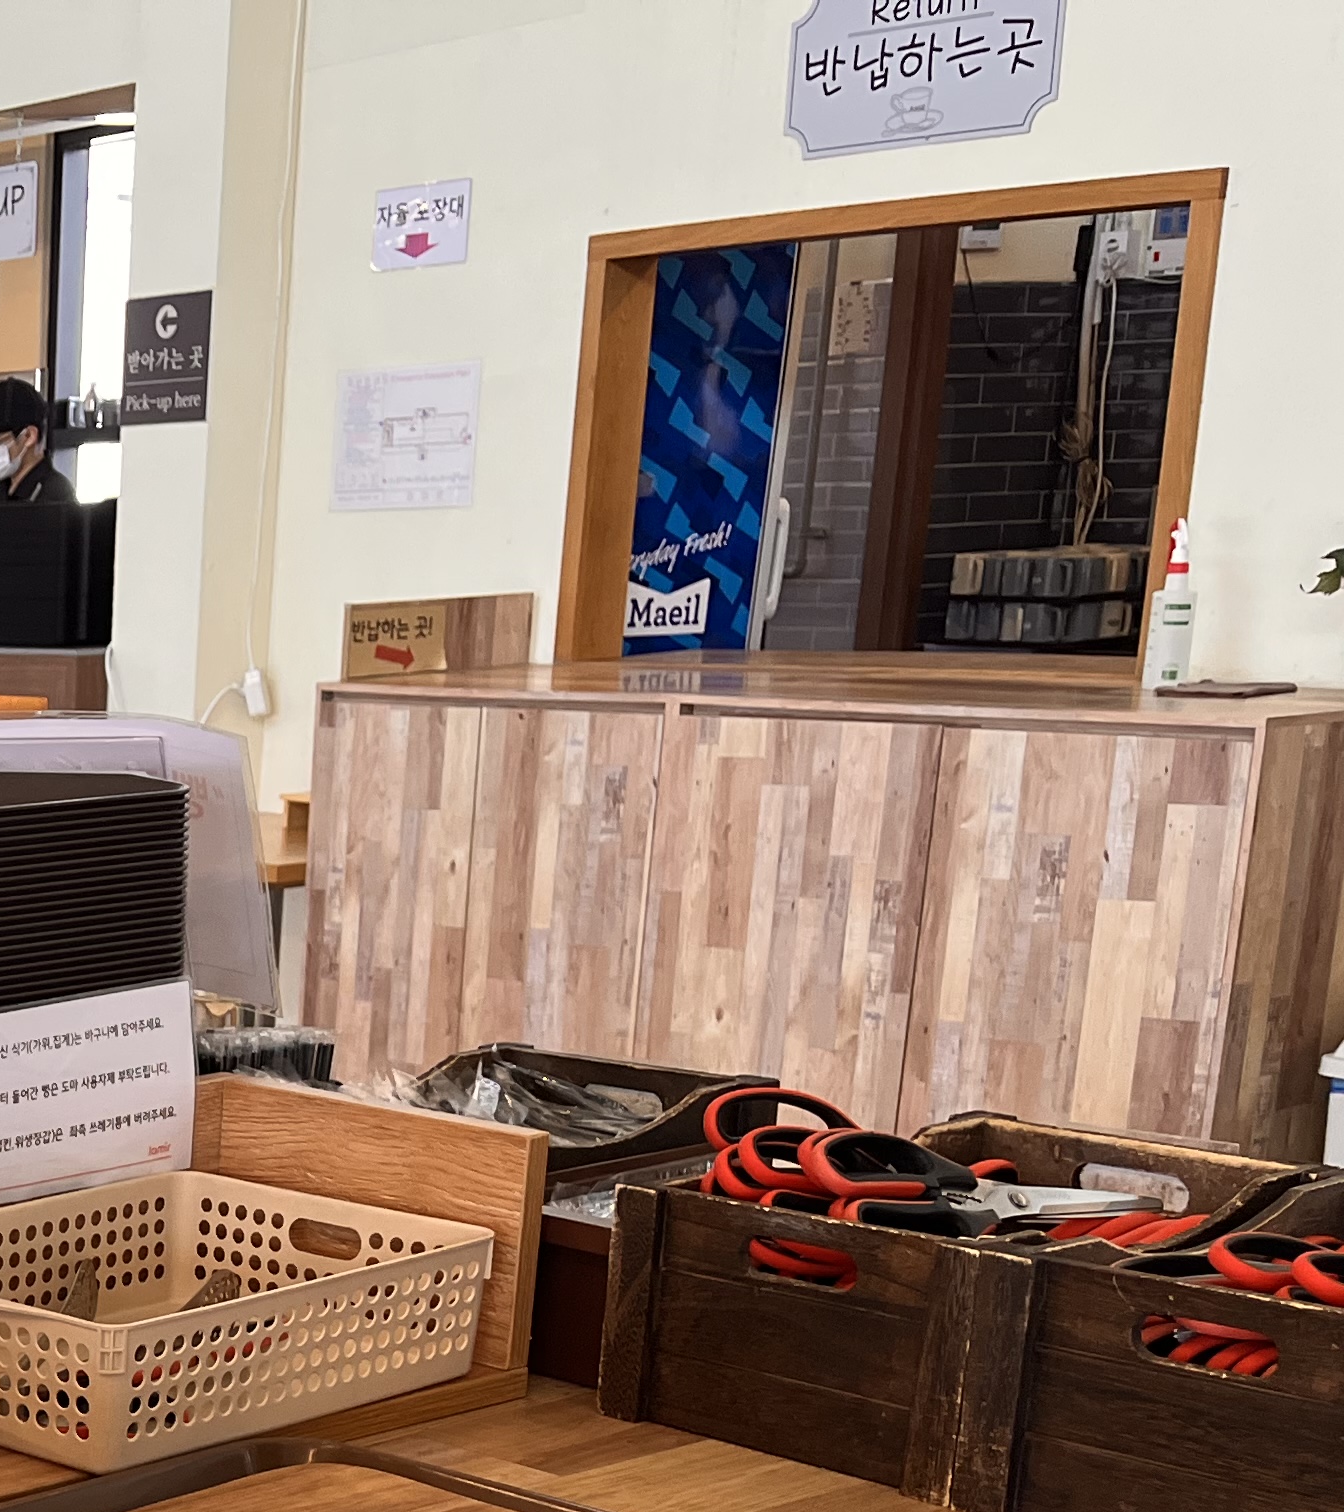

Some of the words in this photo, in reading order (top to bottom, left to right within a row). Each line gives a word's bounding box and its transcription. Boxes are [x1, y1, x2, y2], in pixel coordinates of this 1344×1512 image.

[377, 202, 409, 228] 자율
[414, 194, 465, 222] 포장대
[127, 347, 185, 374] 받아가는
[189, 345, 203, 369] 곳
[125, 393, 172, 413] Pick-up
[175, 390, 201, 408] here
[631, 538, 680, 580] ryday
[683, 520, 732, 557] Fresh!
[627, 593, 700, 628] Maeil
[351, 617, 410, 643] 반납하는
[414, 615, 433, 639] 곳!
[84, 1024, 119, 1042] 바구니에
[121, 1017, 164, 1036] 담아주세요.
[12, 1086, 39, 1104] 들어간
[42, 1082, 58, 1098] 빵은
[62, 1079, 78, 1093] 도마
[81, 1071, 115, 1089] 사용자제
[118, 1061, 170, 1082] 부탁드립니다.
[89, 1114, 131, 1134] 쓰레기통에
[134, 1106, 177, 1124] 버려주세요.
